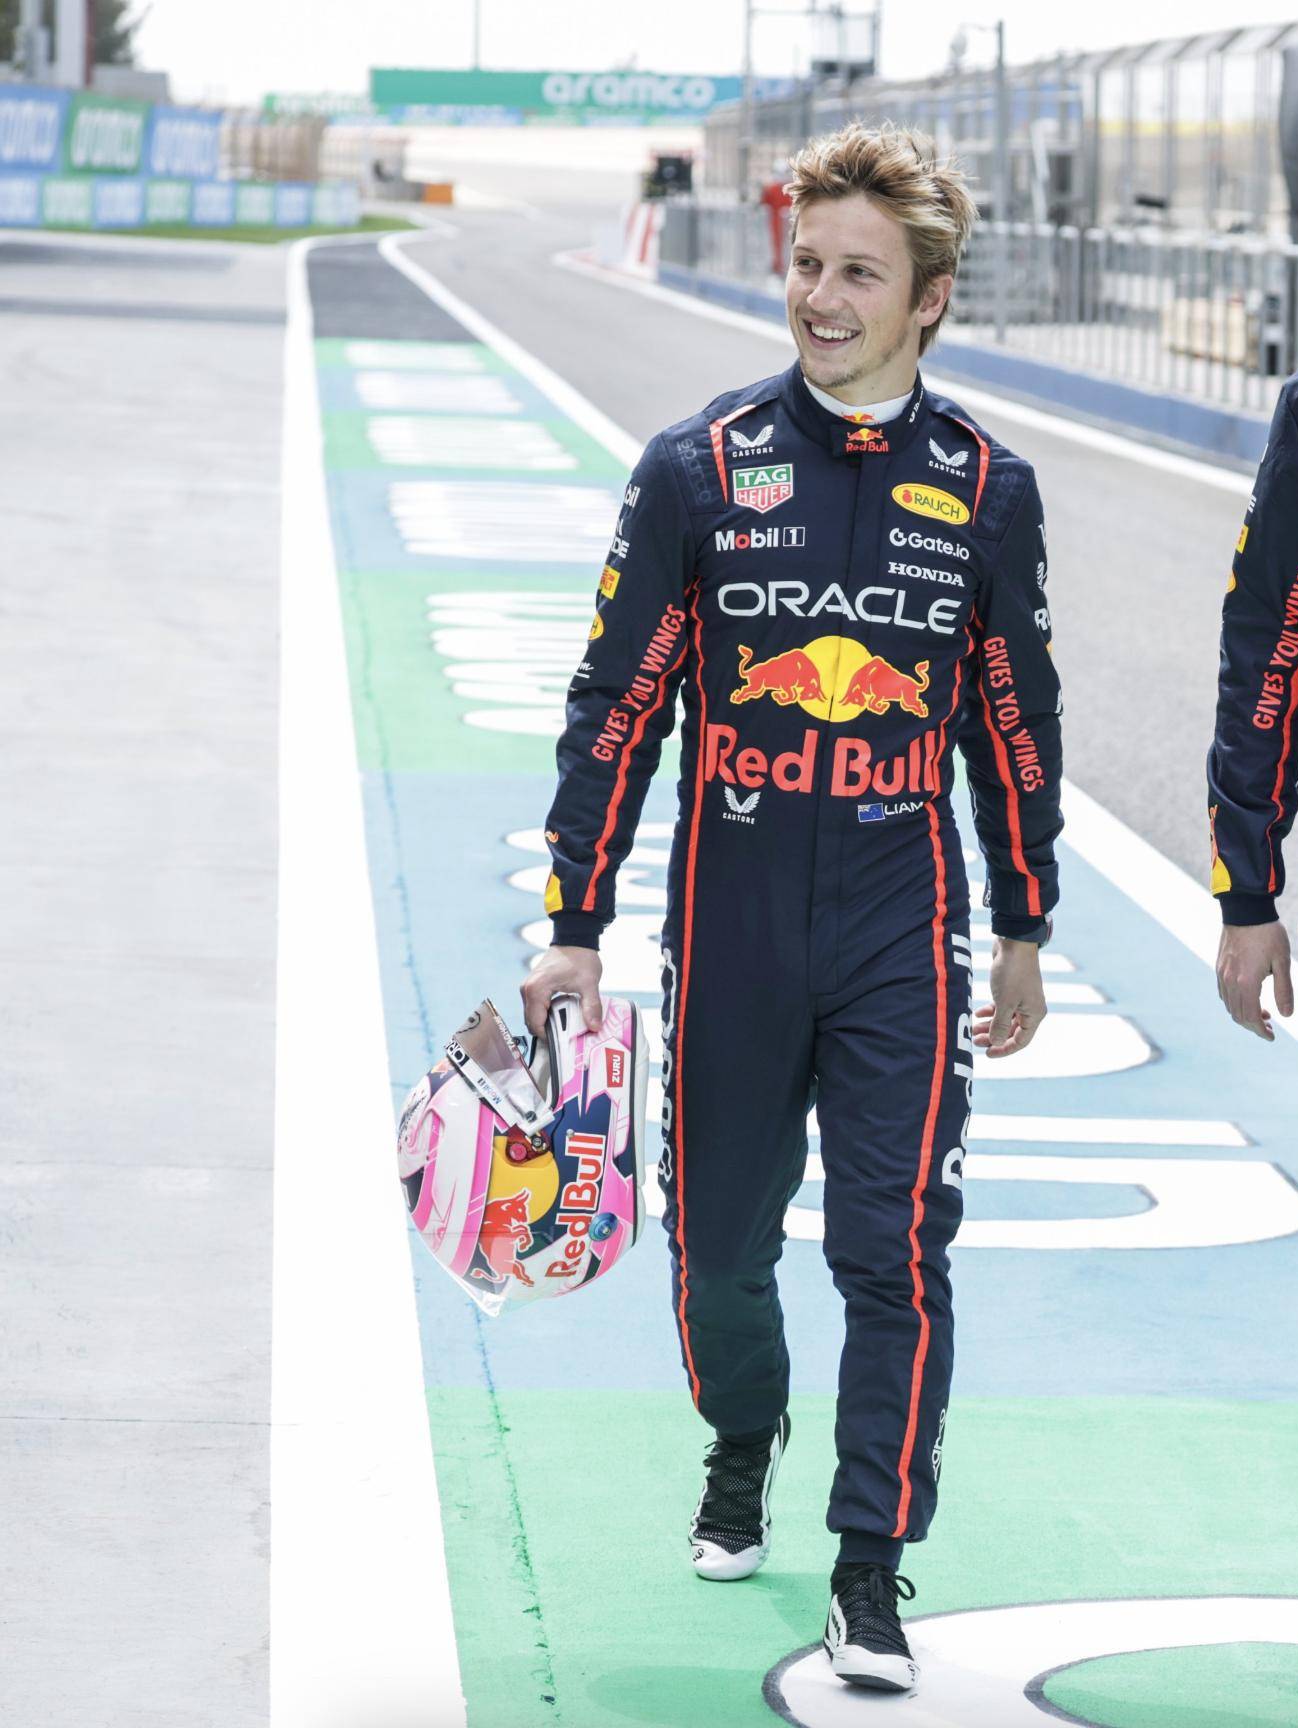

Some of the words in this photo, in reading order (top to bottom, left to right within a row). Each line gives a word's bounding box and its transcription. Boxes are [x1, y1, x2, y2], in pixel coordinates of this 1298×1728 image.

[542, 74, 716, 108] aramco
[732, 446, 774, 458] CASTORE
[846, 441, 868, 453] Red
[869, 439, 889, 453] Bull
[738, 467, 788, 485] TAG
[928, 460, 966, 478] CASTORE
[738, 485, 790, 512] HEUER
[914, 492, 961, 520] RAUCH
[715, 527, 779, 552] Mobil
[785, 527, 802, 545] 1
[906, 532, 970, 560] Gate.io
[888, 561, 966, 587] HONDA
[717, 580, 962, 635] ORACLE
[983, 636, 1013, 687] GIVES
[592, 708, 631, 762] GIVES
[620, 674, 656, 713] YOU
[644, 603, 686, 672] WINGS
[994, 691, 1017, 731] YOU
[1252, 671, 1283, 730] GIVES
[704, 723, 819, 794] Red
[830, 730, 936, 797] Bull
[1009, 729, 1045, 793] WINGS
[722, 812, 756, 825] CASTORE
[884, 801, 924, 817] LIAM
[611, 1054, 621, 1083] ZURU
[563, 1135, 605, 1210] Bull
[545, 1213, 592, 1278] Red
